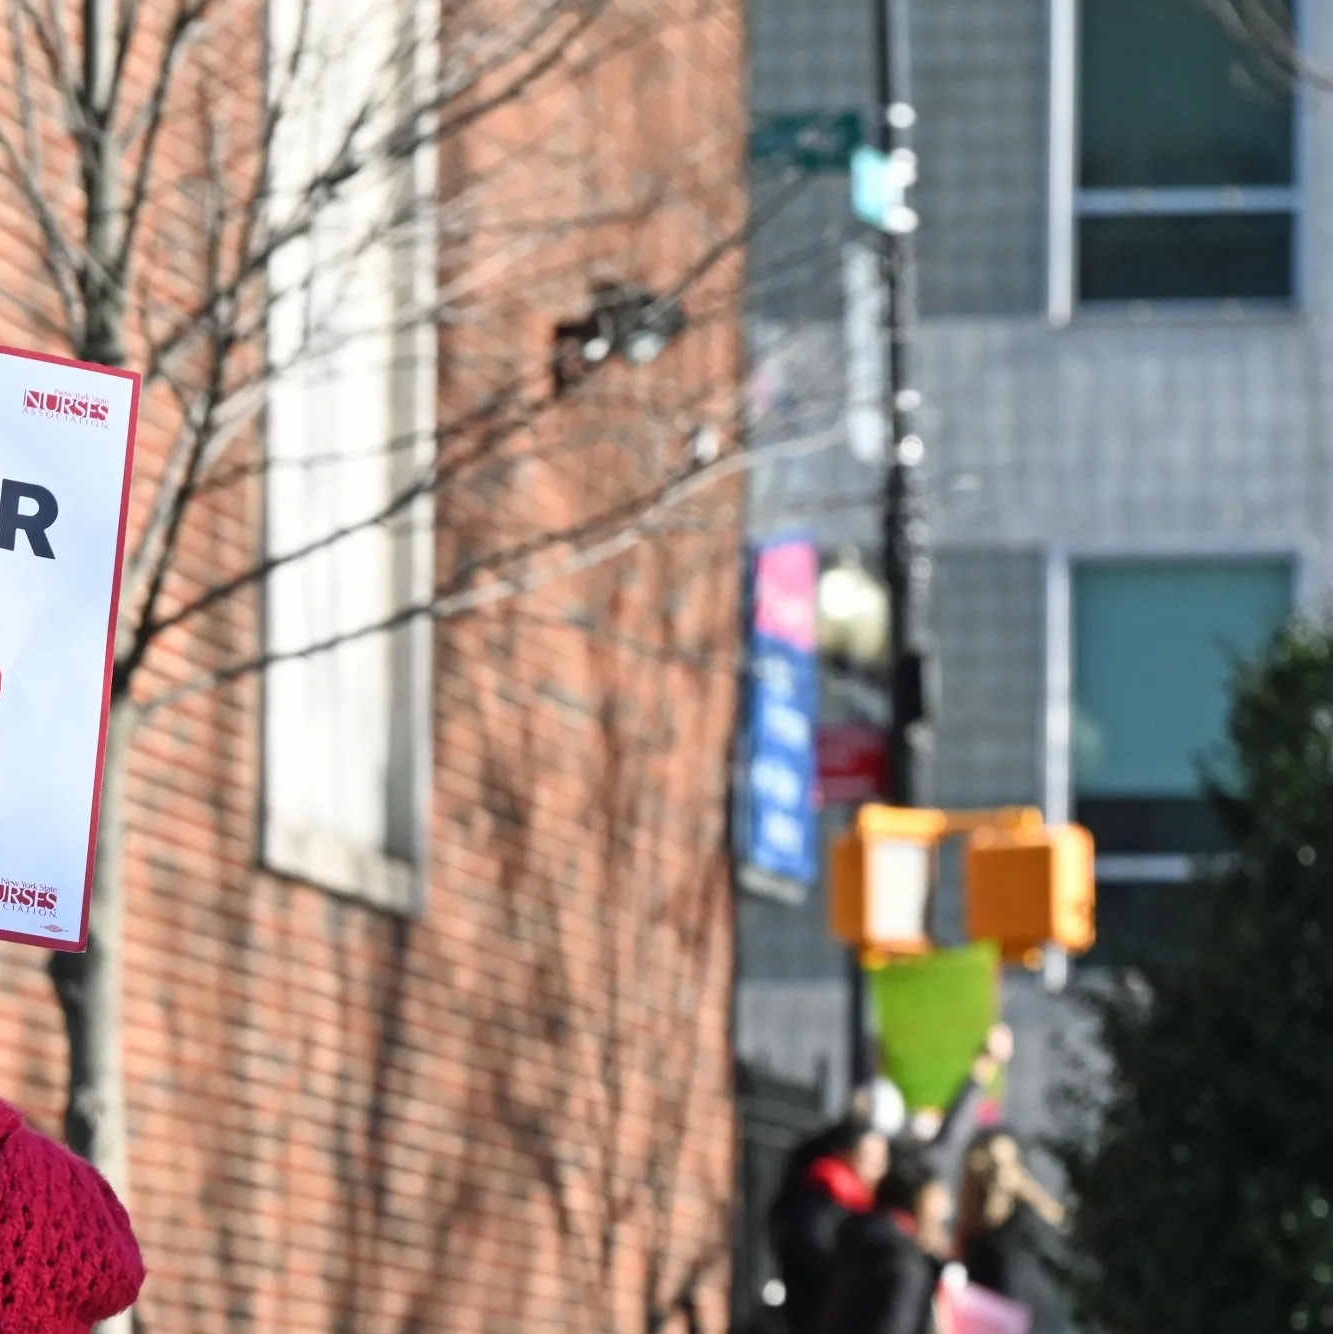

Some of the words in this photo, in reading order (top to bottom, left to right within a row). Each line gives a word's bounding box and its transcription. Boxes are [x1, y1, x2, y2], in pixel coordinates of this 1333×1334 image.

[22, 389, 109, 422] NURSES
[0, 877, 19, 887] New
[20, 880, 38, 891] York
[39, 884, 58, 893] State
